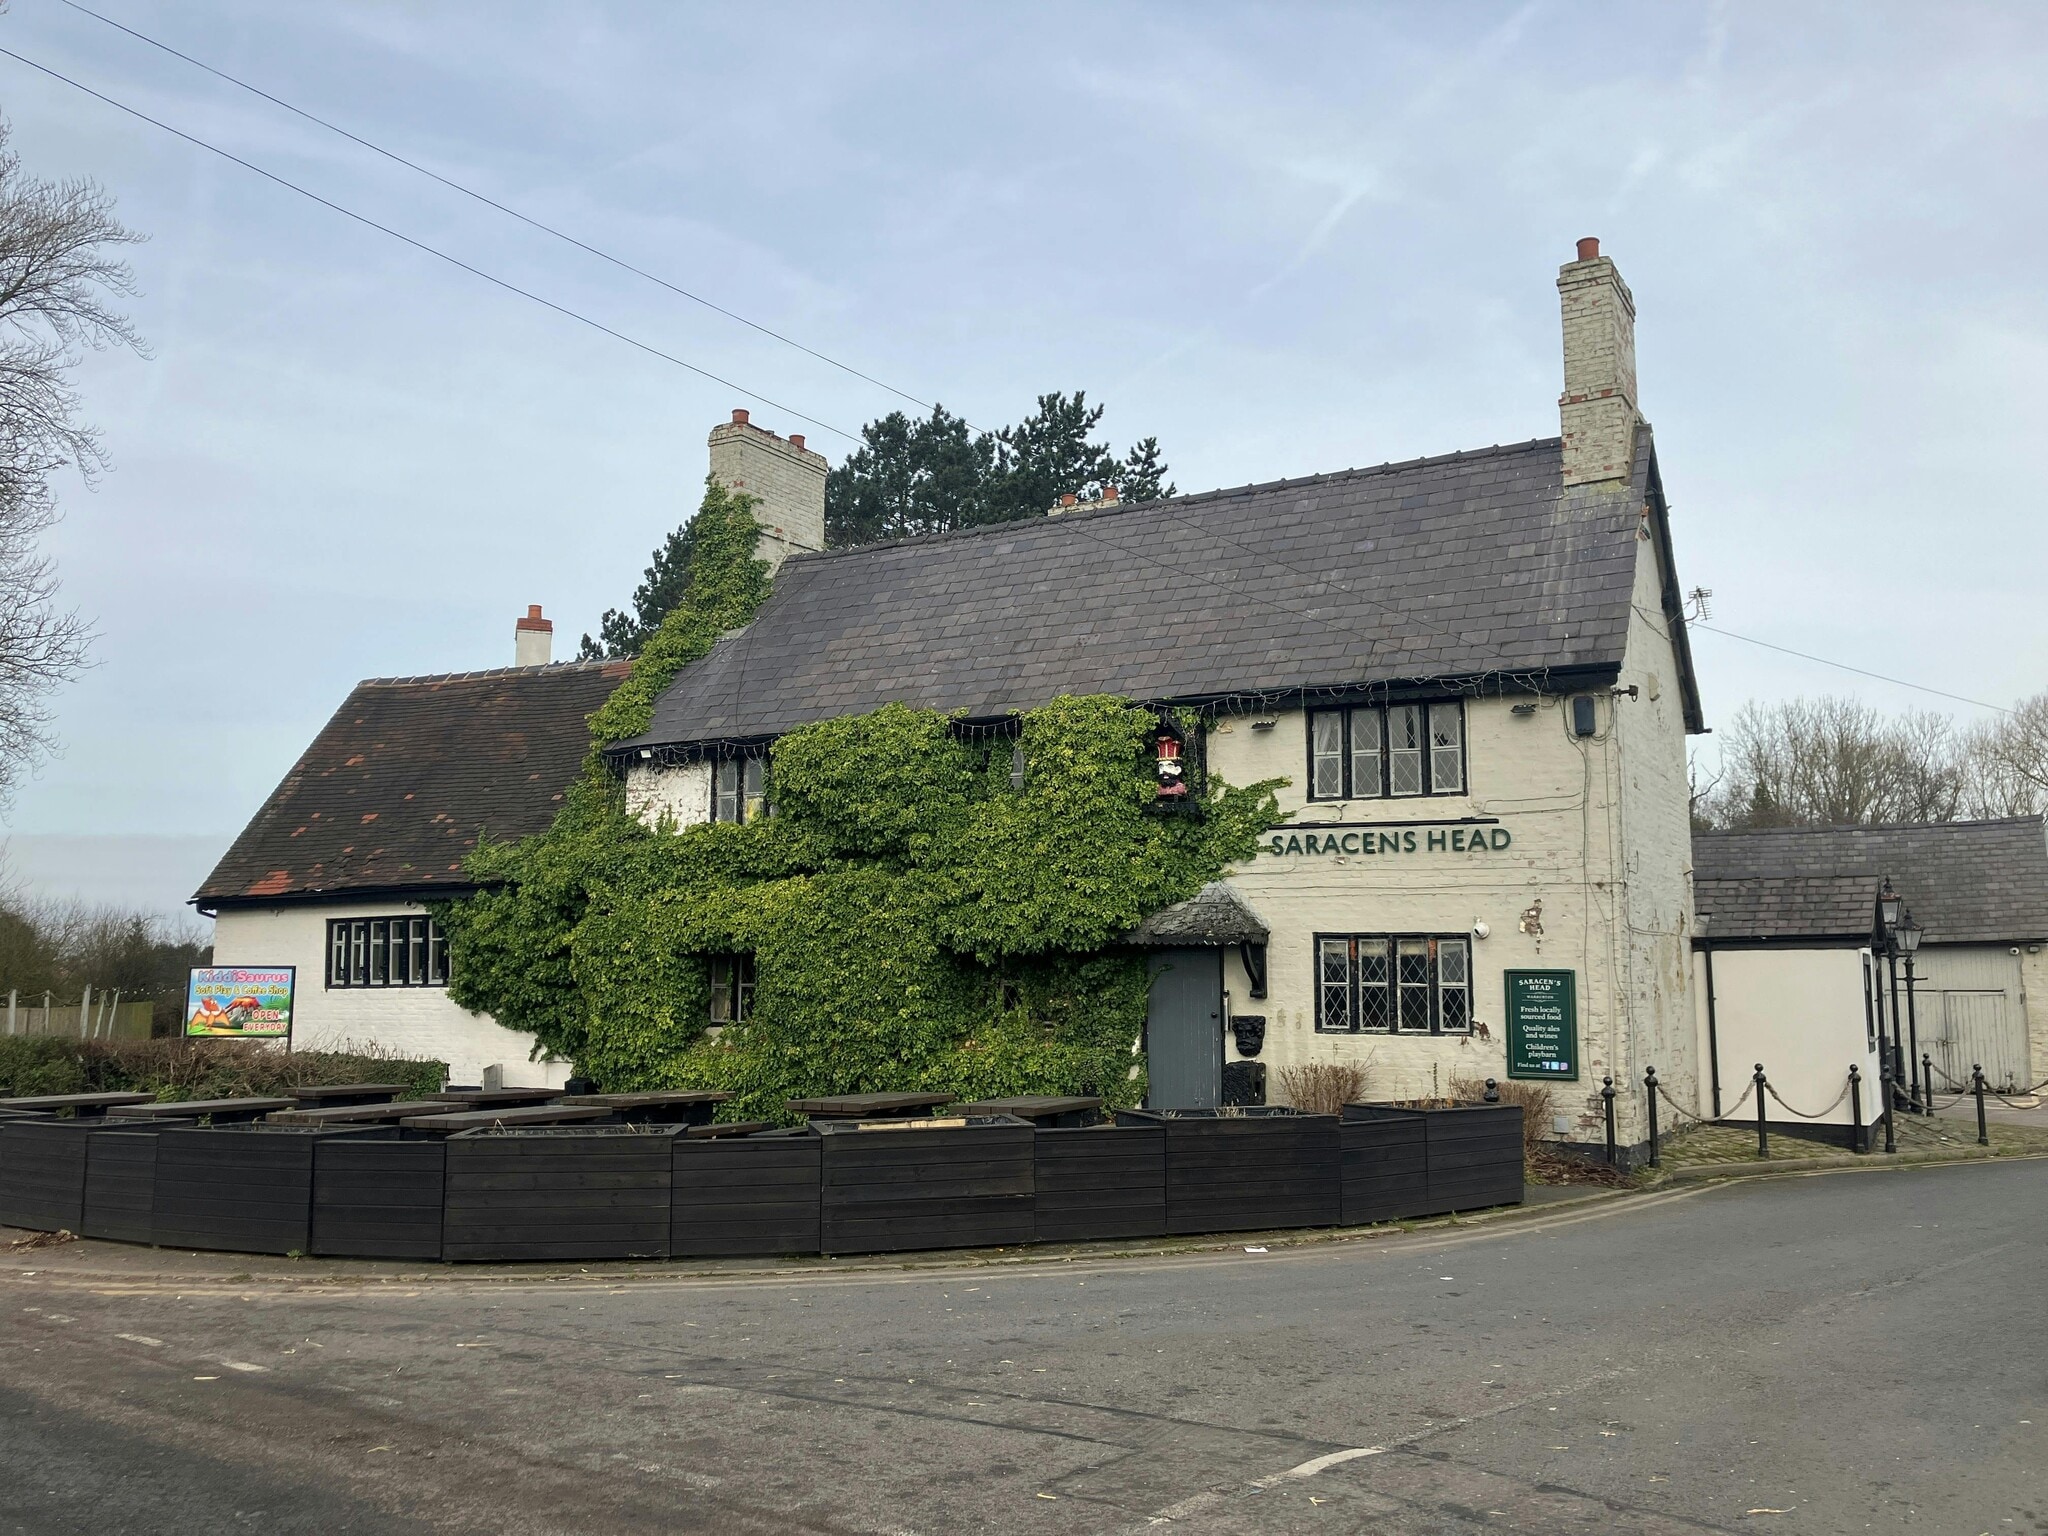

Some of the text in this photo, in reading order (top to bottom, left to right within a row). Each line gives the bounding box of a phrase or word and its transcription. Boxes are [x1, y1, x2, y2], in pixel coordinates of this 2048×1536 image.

[1271, 828, 1511, 857] SARACENS HEAD
[198, 970, 289, 983] KiddiSaurus
[1518, 978, 1561, 987] SARACEN'S
[196, 985, 289, 998] Soft Play & Coffee Shop
[252, 1009, 280, 1020] OPEN
[1540, 1006, 1561, 1014] locally
[243, 1022, 288, 1032] EVERYDAY
[1523, 1025, 1546, 1033] Quality
